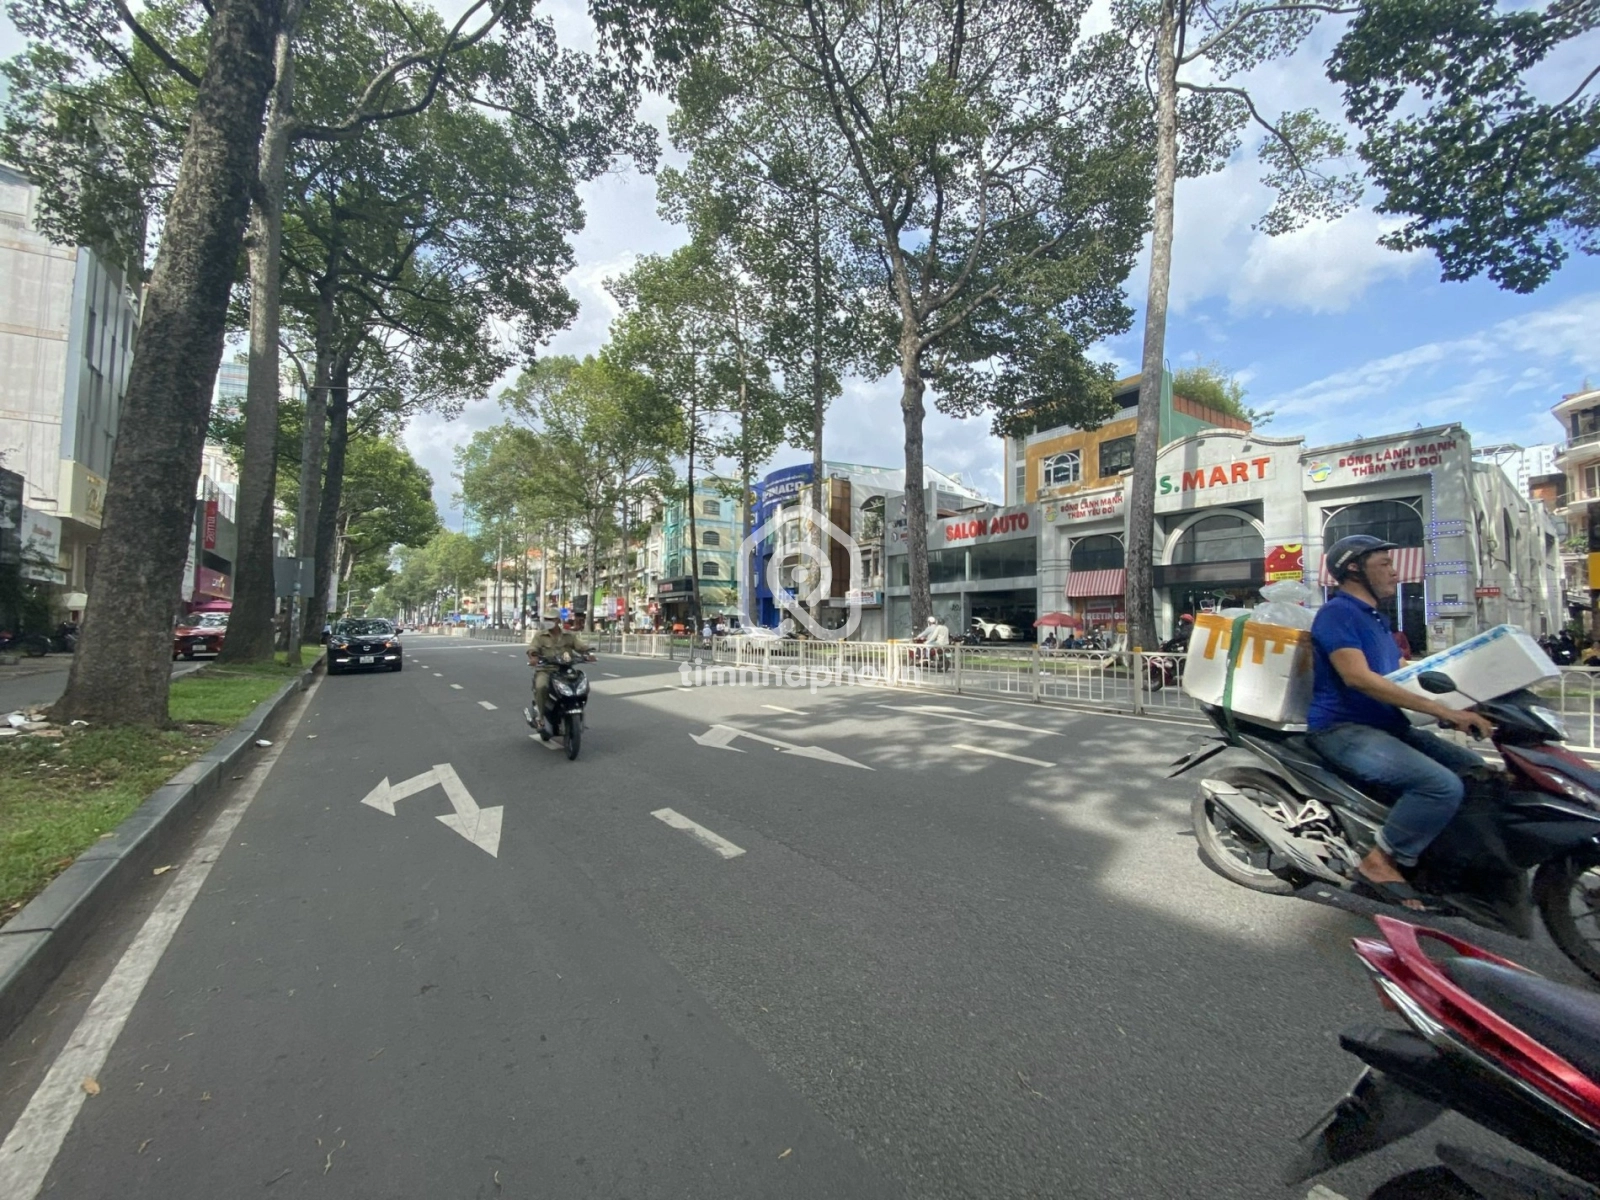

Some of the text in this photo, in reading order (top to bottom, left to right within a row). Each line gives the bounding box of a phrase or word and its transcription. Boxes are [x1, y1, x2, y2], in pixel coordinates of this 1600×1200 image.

[1376, 448, 1411, 462] LÀNH
[1352, 463, 1386, 477] THÊM
[1391, 458, 1415, 471] YÊU
[946, 512, 1029, 541] SALON AUTO
